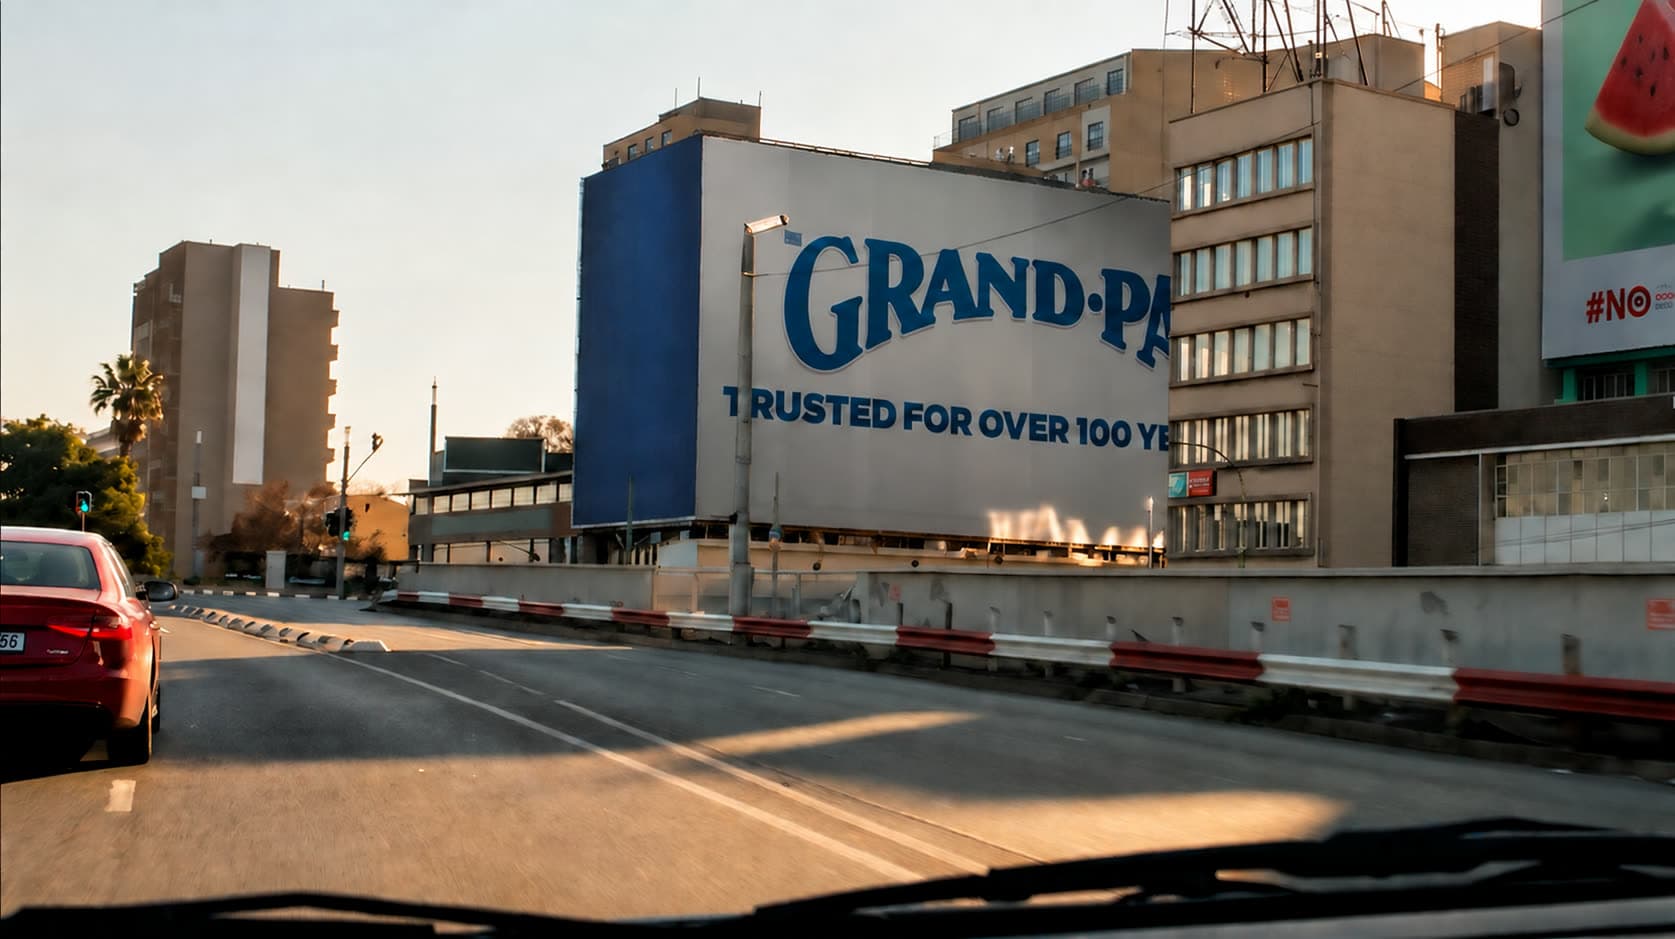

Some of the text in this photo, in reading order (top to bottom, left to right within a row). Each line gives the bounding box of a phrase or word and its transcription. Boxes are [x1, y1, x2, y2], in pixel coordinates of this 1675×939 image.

[723, 386, 896, 429] TRUSTED
[903, 402, 972, 436] FOR
[979, 409, 1069, 443] OVER
[1076, 417, 1132, 448] 100
